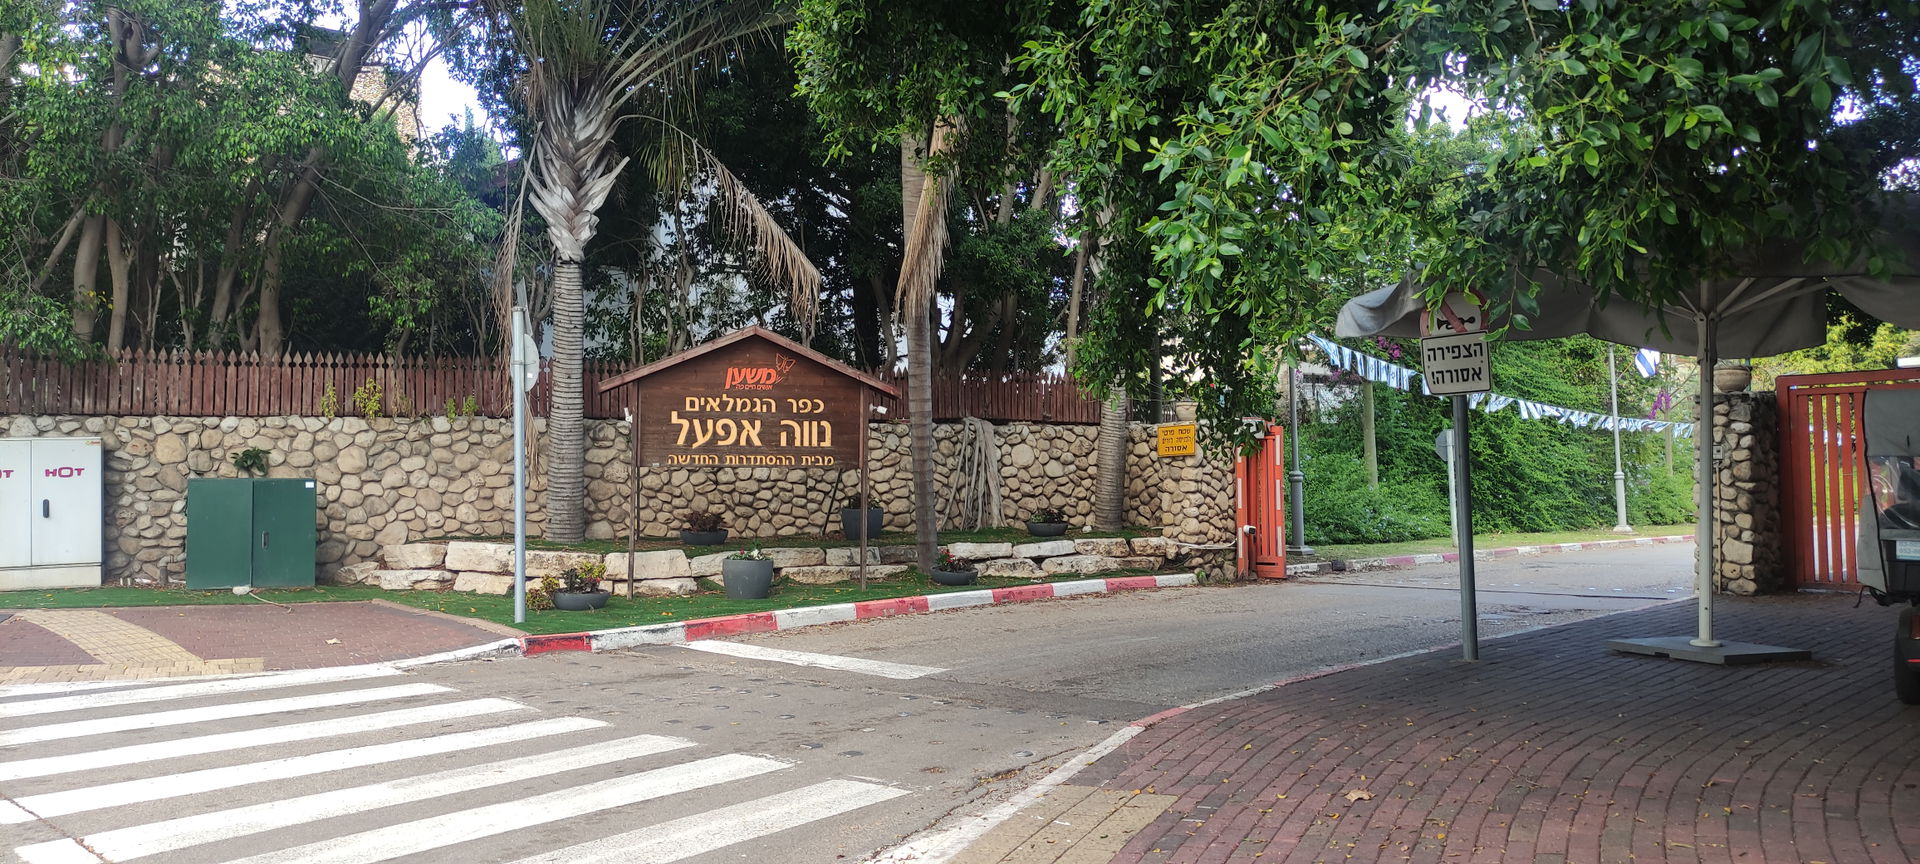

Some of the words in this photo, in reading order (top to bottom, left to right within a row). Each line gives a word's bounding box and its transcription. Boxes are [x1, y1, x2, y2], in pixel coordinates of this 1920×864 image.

[1427, 342, 1483, 362] הצפירה
[724, 366, 777, 390] משען
[1431, 367, 1482, 385] אסורה!
[685, 394, 776, 413] הגמלאים
[787, 398, 825, 414] כפר
[671, 411, 762, 449] אפעל
[780, 419, 832, 447] נווה
[667, 454, 719, 465] החדשה
[725, 454, 795, 466] ההסתדרות
[801, 455, 835, 466] מבית
[45, 467, 85, 478] HOT
